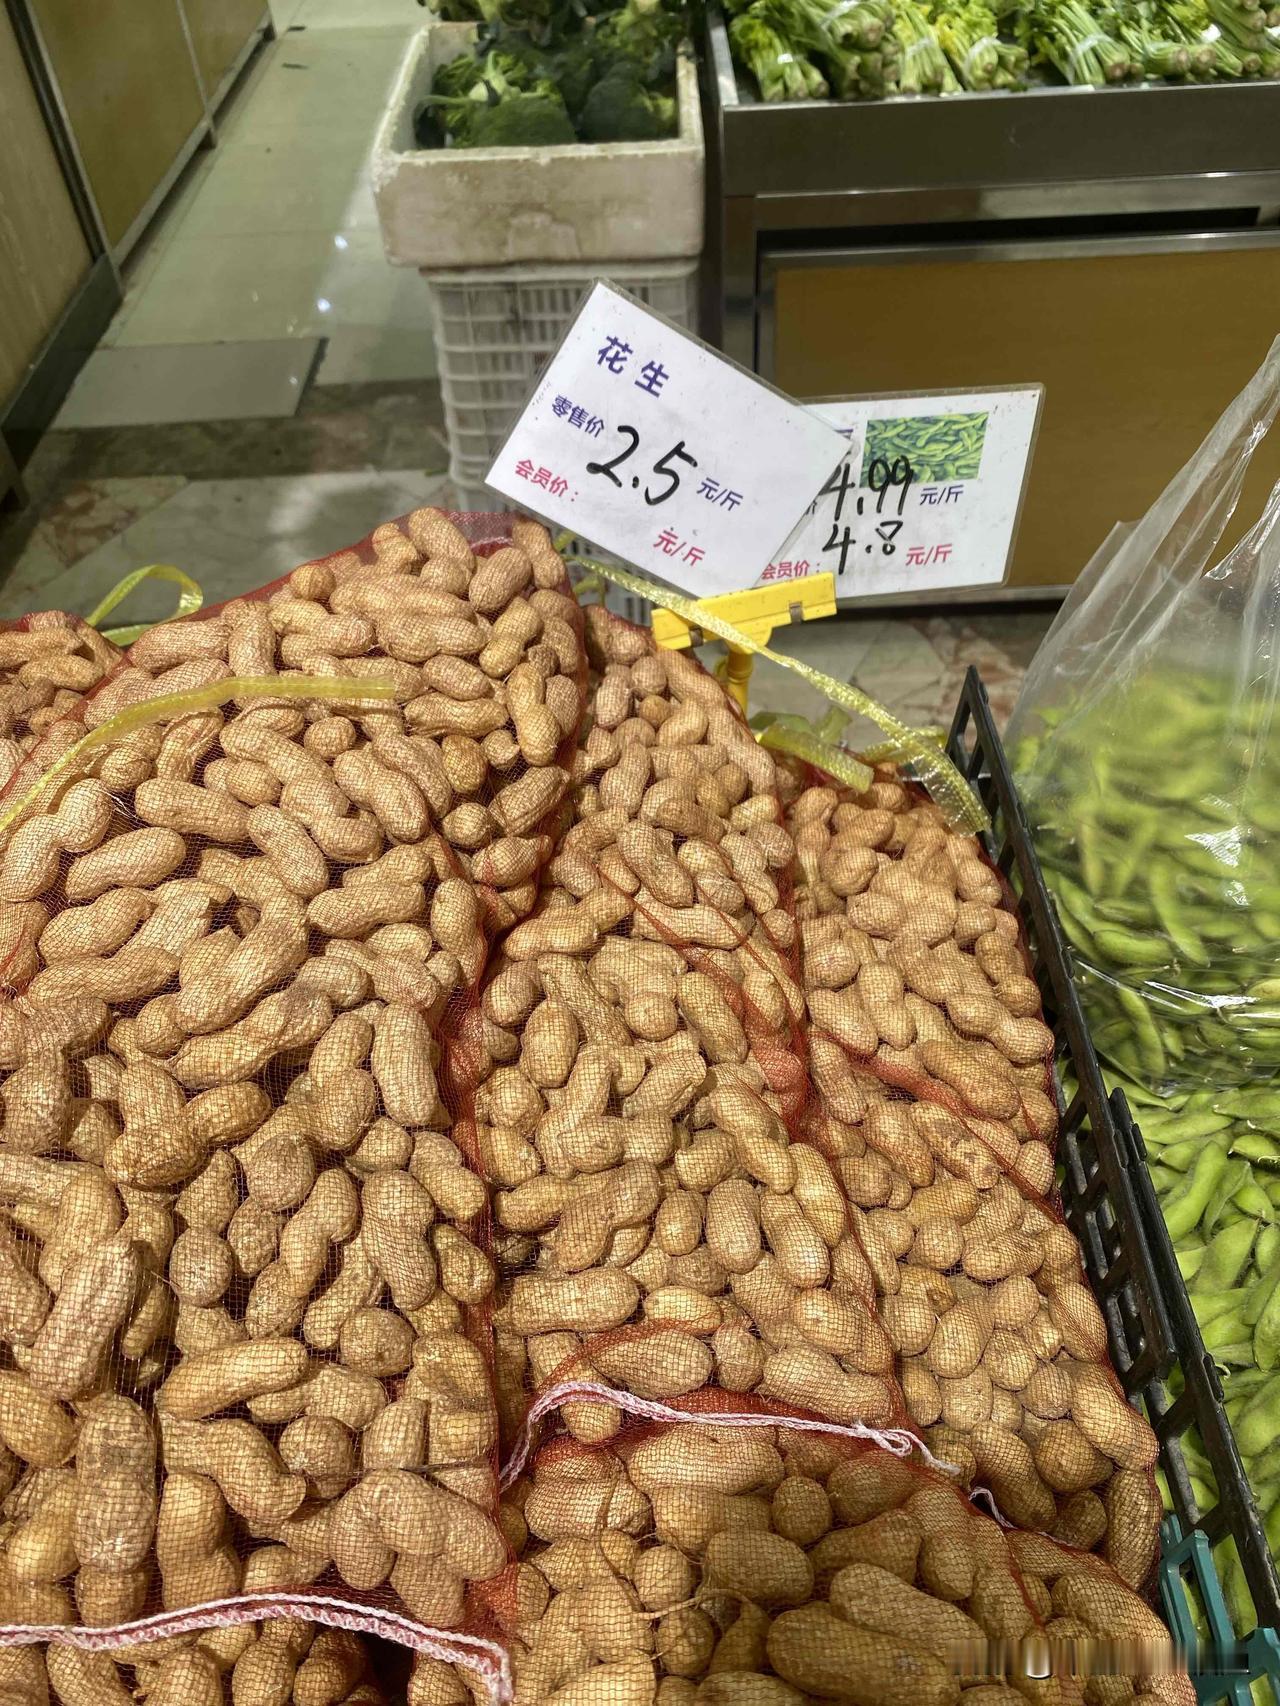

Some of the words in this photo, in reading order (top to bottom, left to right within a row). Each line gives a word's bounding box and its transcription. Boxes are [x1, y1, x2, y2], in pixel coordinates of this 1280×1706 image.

[597, 336, 670, 398] 花生
[551, 394, 605, 438] 零售价
[586, 425, 698, 505] 2.5
[696, 477, 744, 512] 元/斤
[818, 455, 914, 521] 4.99
[919, 484, 964, 506] 元/斤
[653, 528, 706, 567] 元/斤
[822, 521, 903, 575] 4.8
[905, 543, 953, 566] 元/斤
